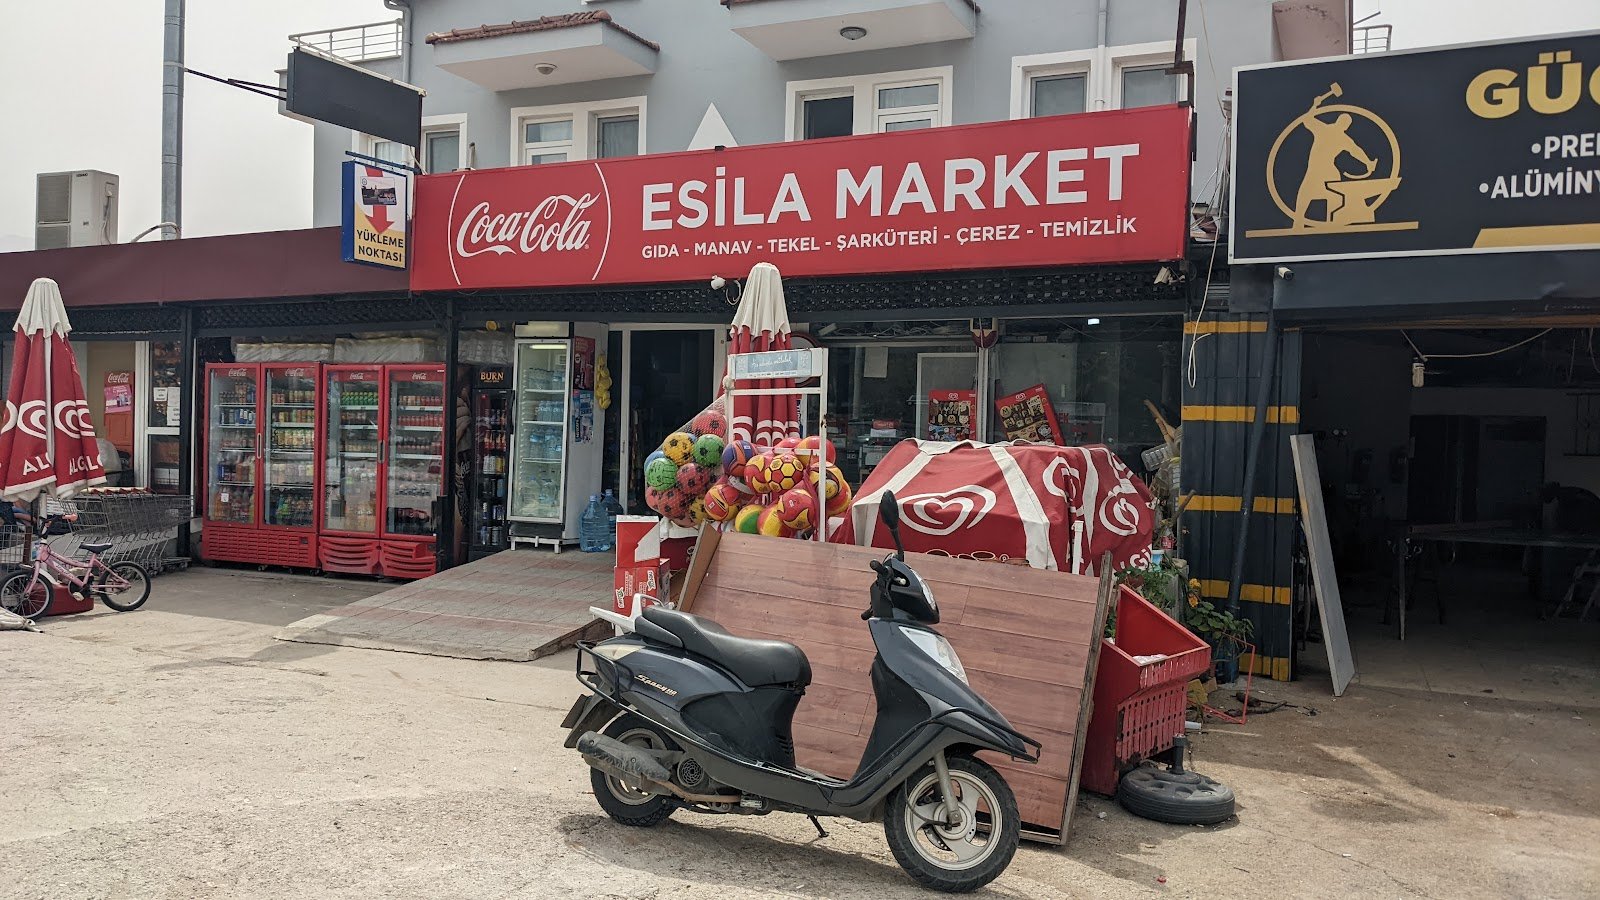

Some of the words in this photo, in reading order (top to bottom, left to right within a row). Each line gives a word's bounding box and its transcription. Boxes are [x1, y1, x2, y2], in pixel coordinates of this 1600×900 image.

[1466, 50, 1600, 119] GÜ
[642, 166, 811, 231] ESİLA
[836, 143, 1140, 219] MARKET
[357, 229, 404, 248] YÜKLEME
[456, 192, 601, 258] Coca-Cola
[641, 244, 679, 259] GIDA
[694, 240, 753, 256] MANAV
[768, 237, 820, 253] TEKEL
[837, 227, 938, 252] ŞARKÜTERİ
[956, 224, 1021, 245] ÇEREZ
[1040, 214, 1137, 238] TEMİZLİK
[358, 245, 402, 262] NOKTASI
[480, 371, 504, 380] BURN
